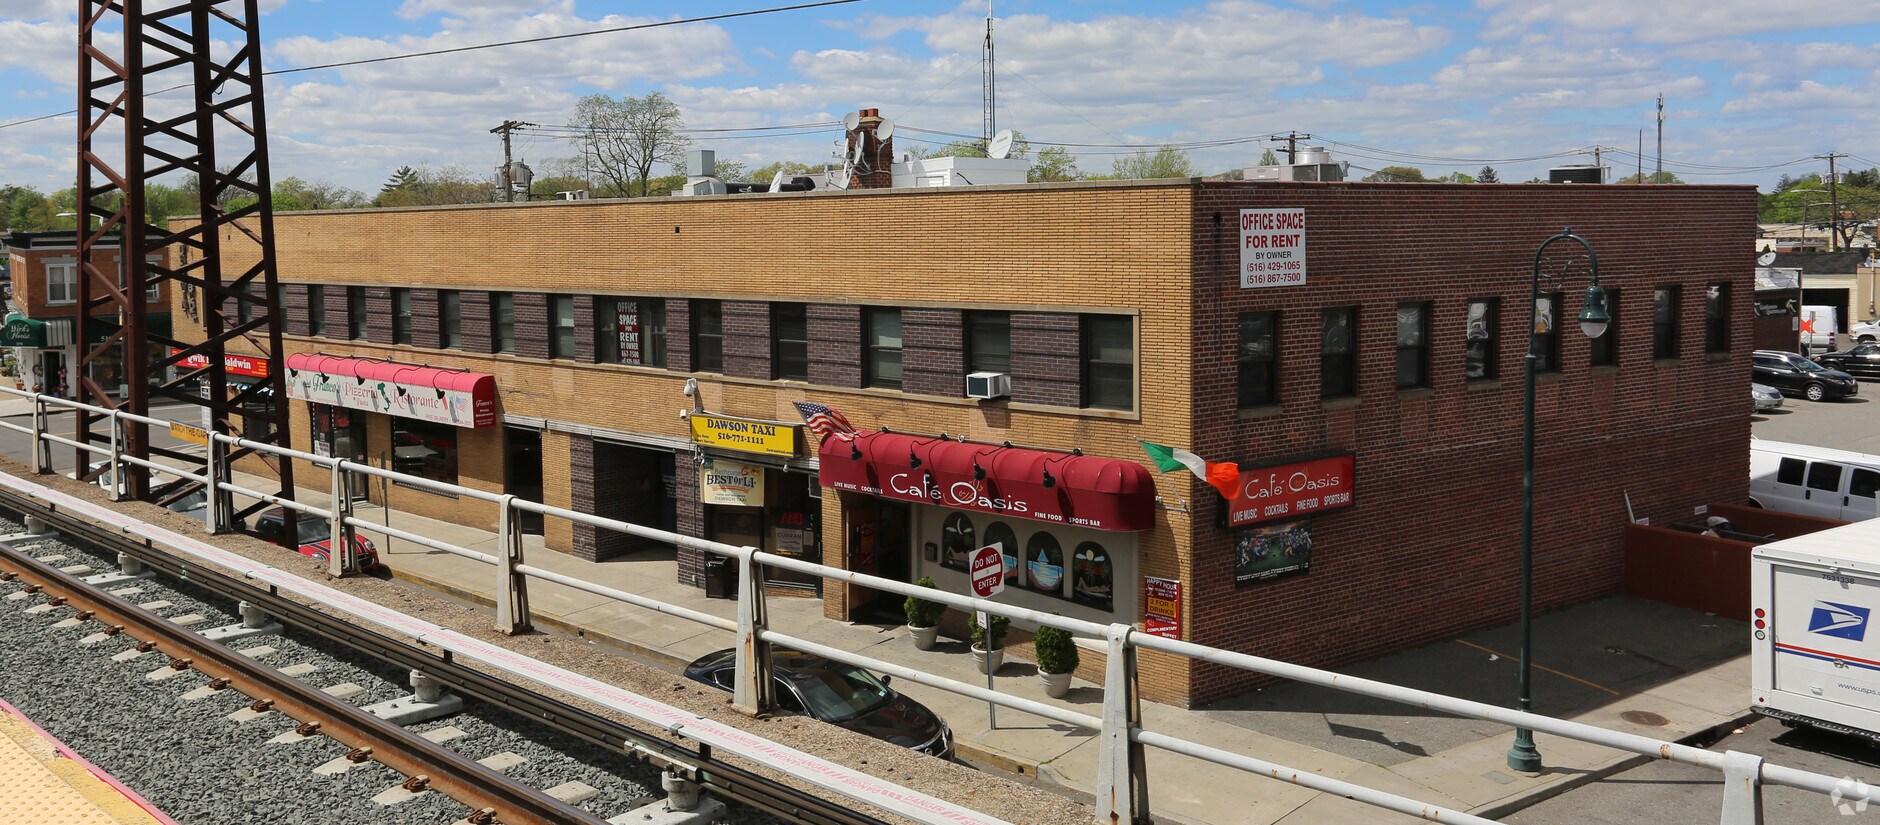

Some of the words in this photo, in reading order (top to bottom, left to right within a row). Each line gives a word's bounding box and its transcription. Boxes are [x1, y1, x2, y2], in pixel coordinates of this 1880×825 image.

[1242, 213, 1274, 230] OFFICE
[1276, 212, 1304, 230] SPACE
[1246, 235, 1268, 248] FOR
[1272, 234, 1300, 248] RENT
[1266, 251, 1292, 259] OWNER
[1246, 262, 1266, 272] (516)
[1267, 261, 1300, 270] 429-1065
[1246, 274, 1266, 284] (516)
[1267, 273, 1300, 282] 867-7500
[618, 302, 636, 312] OFFICE
[619, 314, 637, 326] SPACE
[620, 332, 638, 342] RENT
[343, 382, 378, 399] Pizzeria
[393, 388, 438, 410] Ristorante
[707, 418, 748, 432] DAWSON
[751, 424, 776, 436] TAXI
[706, 474, 733, 486] BEST
[1245, 474, 1284, 499] Café
[1288, 472, 1340, 492] Oasis
[861, 486, 883, 494] COCKTAILS
[890, 474, 942, 500] Café
[950, 482, 1028, 512] Oasis
[1048, 513, 1062, 521] FOOD
[1068, 516, 1088, 525] SPORTS
[1090, 518, 1100, 526] BAR
[1234, 510, 1243, 522] LIVE
[1244, 508, 1258, 520] MUSIC
[1264, 502, 1288, 516] COCKTAILS
[1296, 500, 1306, 510] FINE
[1307, 498, 1318, 509] FOOD
[1324, 494, 1340, 506] SPORTS
[1340, 492, 1350, 502] BAR
[974, 558, 984, 568] DO
[986, 553, 998, 564] NOT
[978, 576, 997, 590] ENTER
[1146, 578, 1162, 587] HAPPY
[1822, 574, 1854, 584] 7531338
[1150, 606, 1174, 616] DRINKS
[902, 795, 946, 812] DANGER
